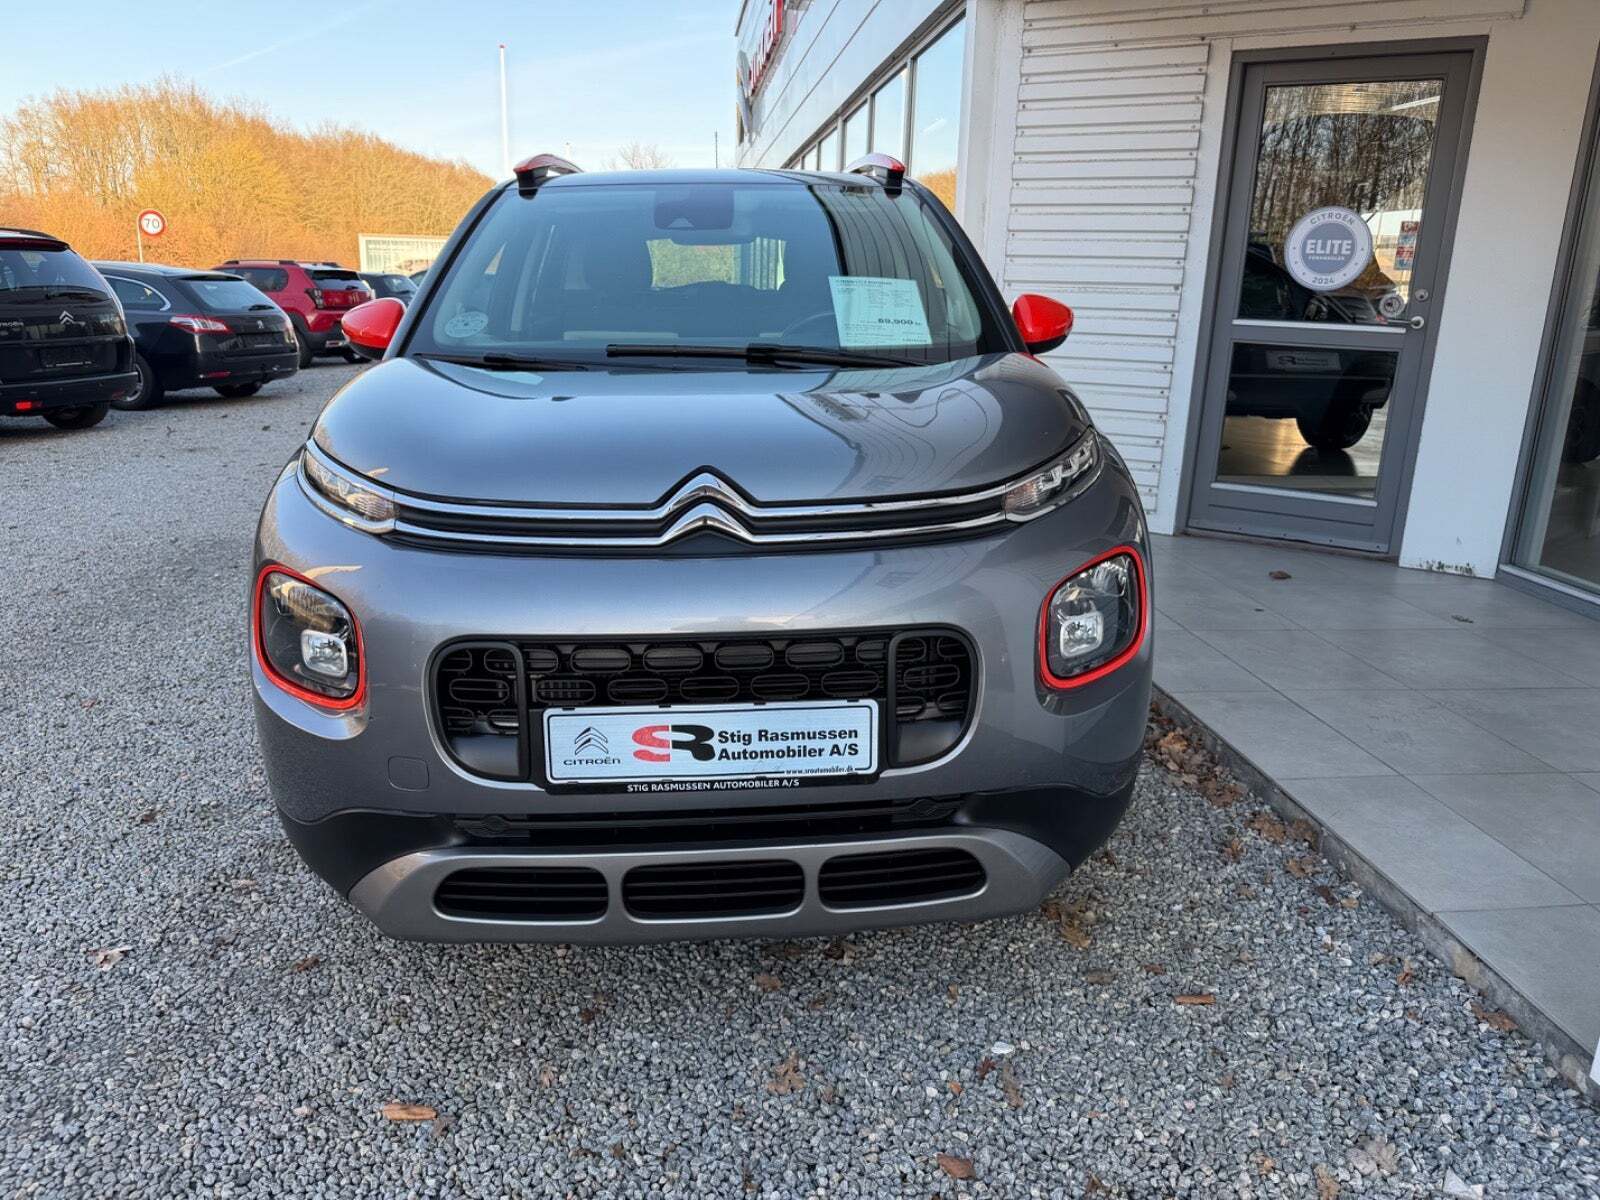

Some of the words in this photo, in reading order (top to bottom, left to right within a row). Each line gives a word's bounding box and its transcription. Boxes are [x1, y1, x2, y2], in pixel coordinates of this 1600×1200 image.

[144, 218, 160, 229] 70
[1305, 239, 1352, 255] ELITE
[1312, 276, 1335, 285] 2024
[717, 730, 752, 746] Stig
[758, 728, 858, 743] Rasmussen
[717, 745, 825, 761] Automobiler
[829, 743, 859, 757] A/S
[627, 783, 649, 793] STIG
[651, 782, 711, 792] RASMUSSEN
[713, 779, 780, 790] AUTOMOBILER
[782, 778, 800, 787] A/S
